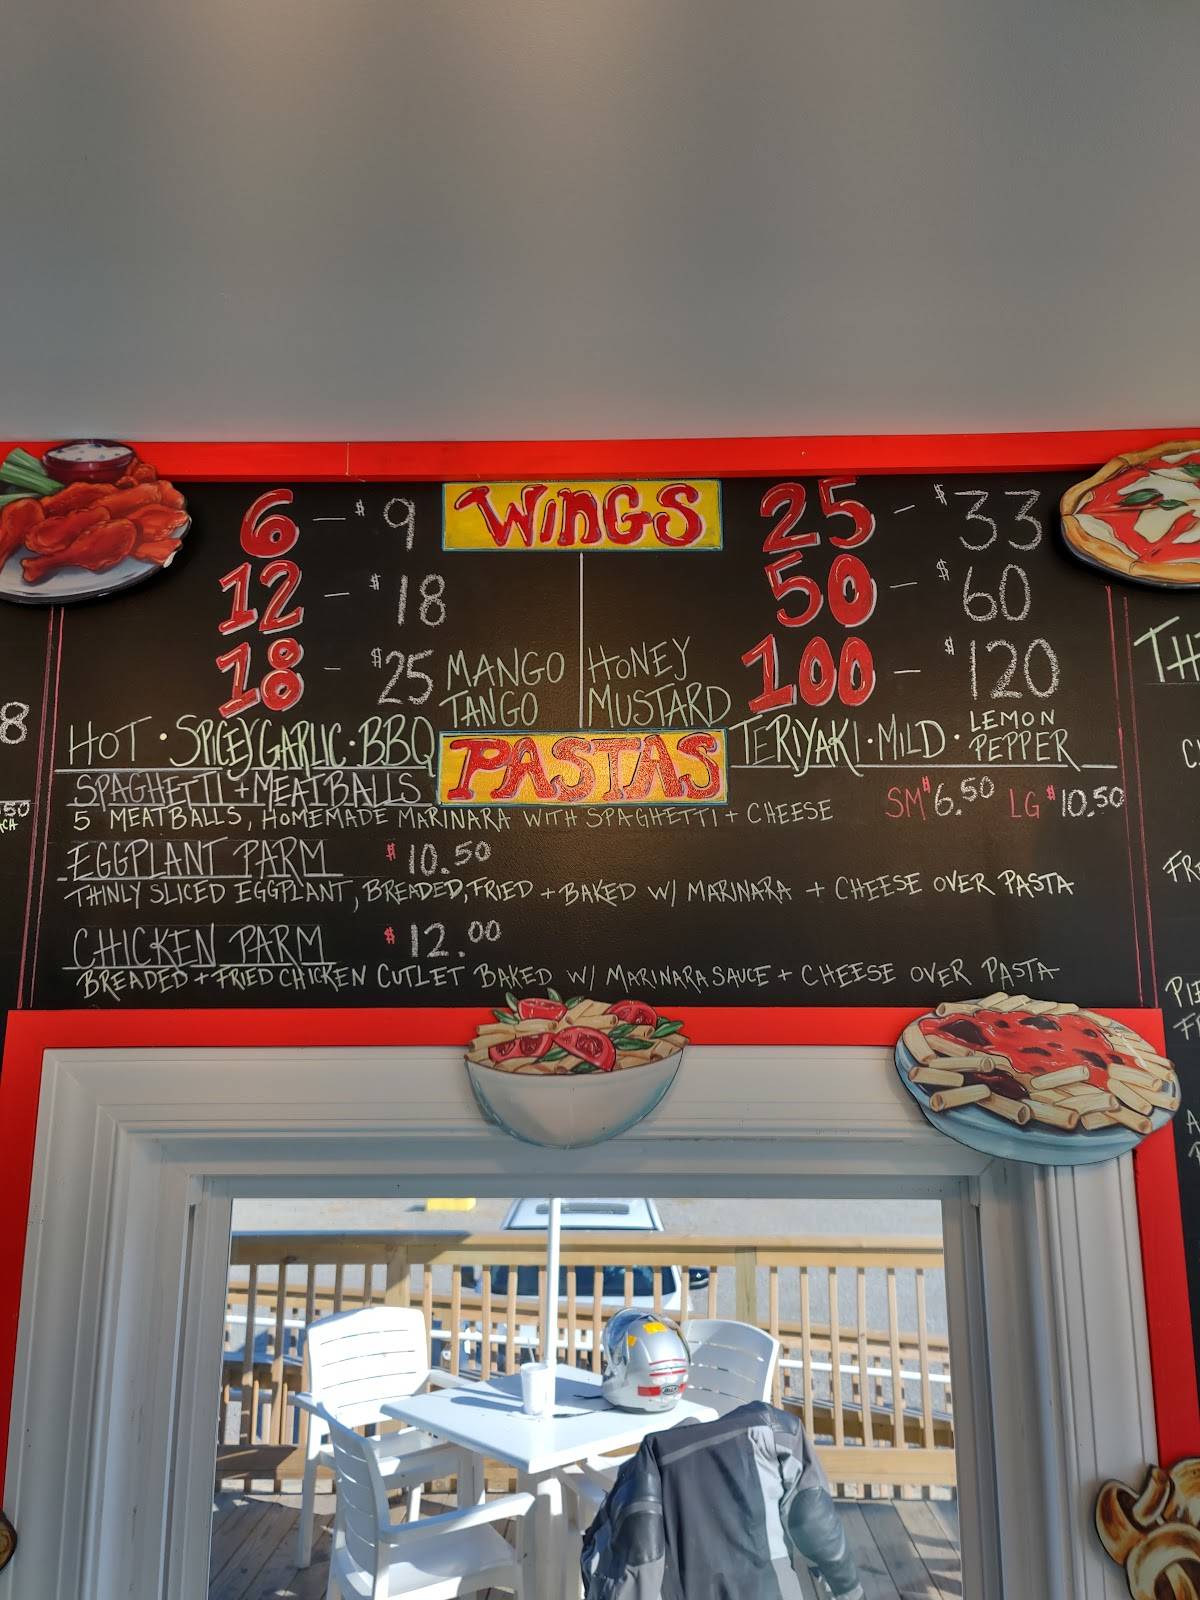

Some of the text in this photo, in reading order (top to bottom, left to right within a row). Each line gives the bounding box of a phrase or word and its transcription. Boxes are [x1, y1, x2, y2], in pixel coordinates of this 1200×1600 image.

[240, 488, 299, 557] 6
[759, 477, 876, 553] 25
[934, 484, 1043, 551] $33
[218, 559, 304, 635] 12
[764, 551, 878, 628] 50
[937, 559, 1031, 622] $60
[215, 637, 305, 717] 18
[371, 648, 434, 706] $25
[447, 648, 565, 690] MANGO
[588, 636, 690, 683] HONEY
[741, 634, 877, 714] 100
[944, 637, 1061, 699] $120
[438, 688, 539, 729] TANGO
[588, 682, 732, 728] MUSTARD
[970, 710, 1055, 733] LEMON
[68, 716, 152, 765] HOT
[259, 719, 347, 778] GARLIC
[357, 713, 436, 777] BBQ
[878, 713, 946, 761] MILD
[969, 729, 1081, 772] PEPPER
[447, 731, 722, 802] PASTAS
[74, 770, 224, 812] SPAGHETTI
[253, 769, 422, 812] MEATBALLS
[884, 786, 926, 820] SM
[1009, 788, 1040, 819] LG
[73, 810, 91, 831] 5
[263, 808, 389, 830] HOMEMADE
[399, 807, 511, 832] MARINARA
[523, 808, 577, 828] WITH
[586, 807, 718, 828] SPAGHETTI
[747, 799, 833, 824] CHEESE
[67, 836, 326, 886] EGGPLANT PARM
[64, 881, 142, 909] THINLY
[150, 880, 225, 905] SLICED
[558, 879, 636, 907] BAKED
[647, 879, 676, 907] W/
[688, 875, 792, 904] MARINARA
[835, 872, 922, 901] CHEESE
[933, 870, 996, 896] OVER
[997, 869, 1075, 898] PASTA
[73, 923, 326, 974] CHICKEN PARM
[76, 967, 188, 1000] BREADED
[211, 966, 274, 990] FRIED
[279, 962, 367, 992] CHICKEN
[377, 963, 466, 988] CUTLET
[473, 963, 552, 989] BAKED
[566, 964, 595, 991] W/
[606, 964, 709, 994] MARINARA
[712, 964, 771, 988] SAUCE
[801, 962, 896, 988] CHEESE
[910, 958, 972, 987] OVER
[981, 956, 1060, 990] PASTA
